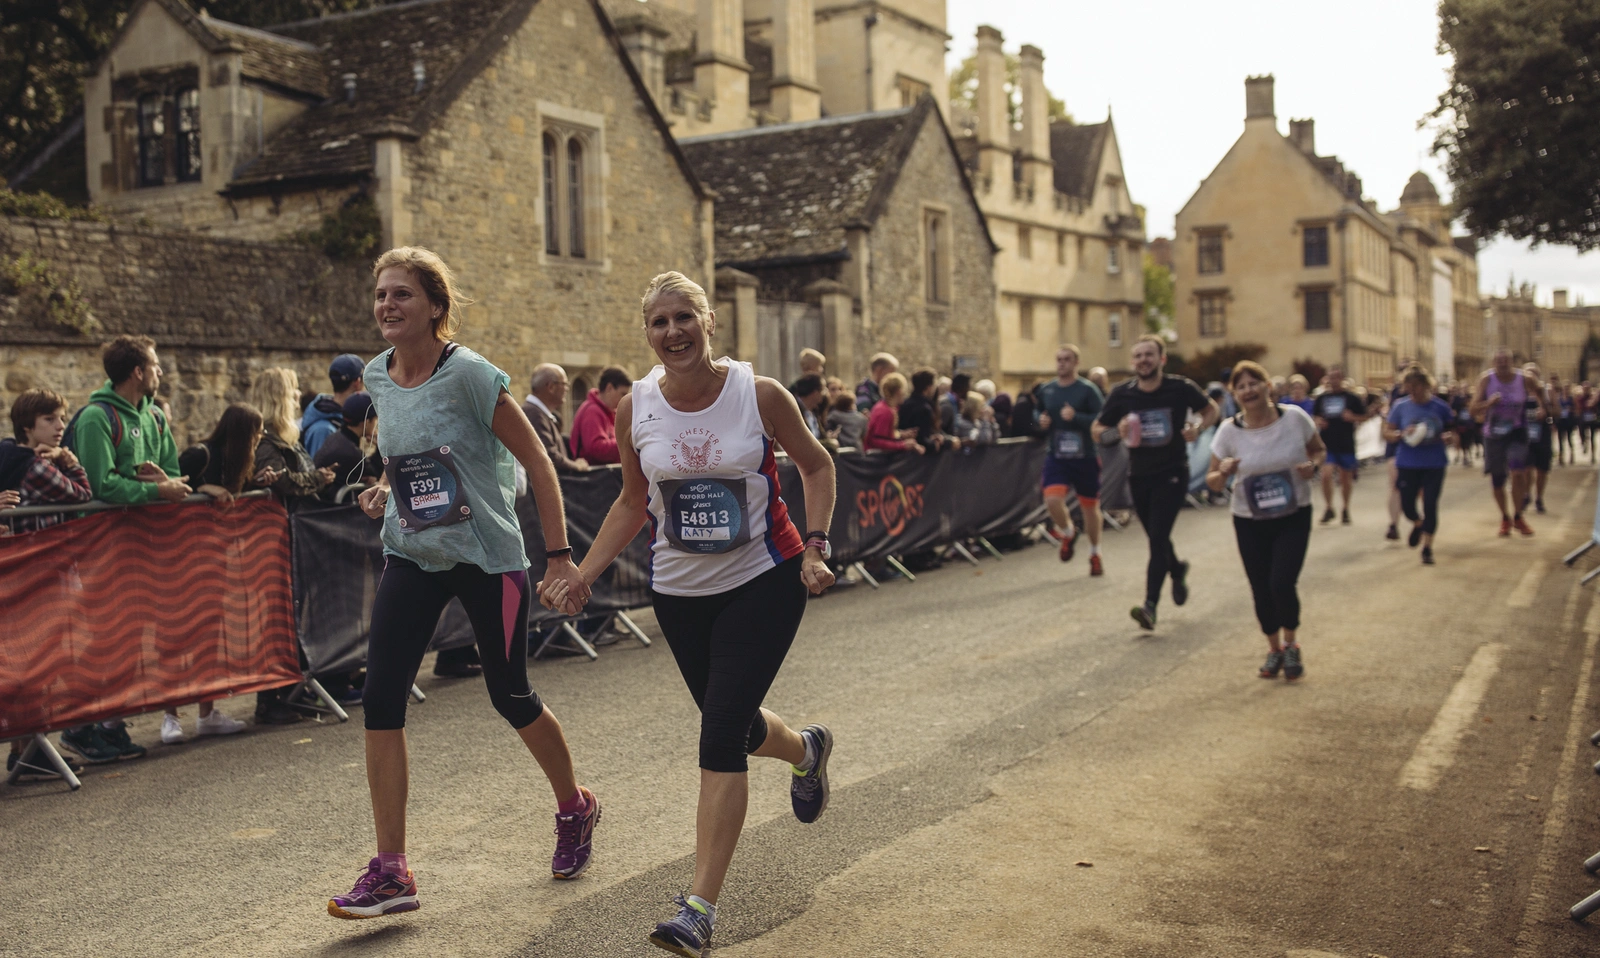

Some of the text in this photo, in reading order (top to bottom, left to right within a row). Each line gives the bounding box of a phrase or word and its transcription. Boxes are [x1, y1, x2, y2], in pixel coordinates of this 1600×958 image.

[671, 427, 720, 450] ALCHESTER
[669, 449, 723, 474] RUNNING CLUB
[409, 477, 441, 494] F397
[690, 483, 712, 493] SPORT
[413, 494, 440, 506] SARAH
[681, 510, 729, 525] E4813
[684, 528, 714, 538] KATY
